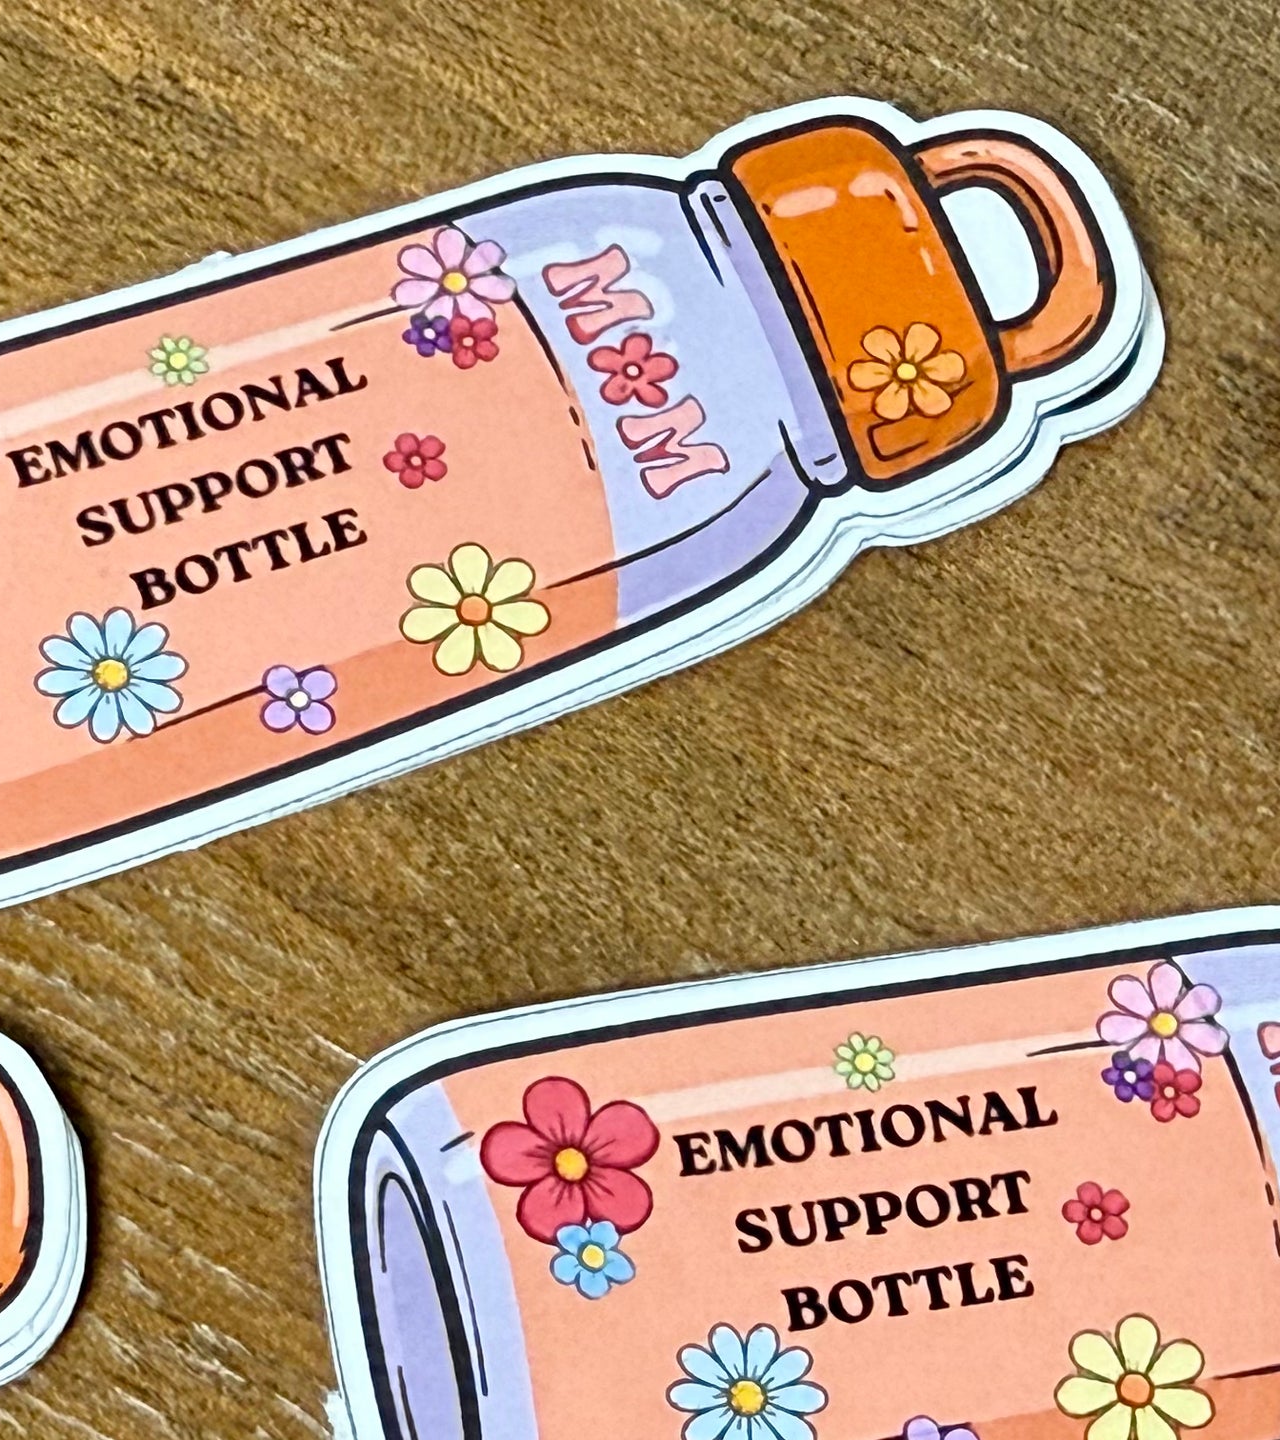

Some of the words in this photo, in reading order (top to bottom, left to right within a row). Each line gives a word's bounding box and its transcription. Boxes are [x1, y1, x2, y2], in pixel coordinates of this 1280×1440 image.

[5, 356, 369, 489] EMOTIONAL
[75, 432, 353, 548] SUPPORT
[128, 507, 368, 611] BOTTLE
[671, 1085, 1059, 1178] EMOTIONAL
[734, 1169, 1032, 1254] SUPPORT
[780, 1253, 1035, 1333] BOTTLE
